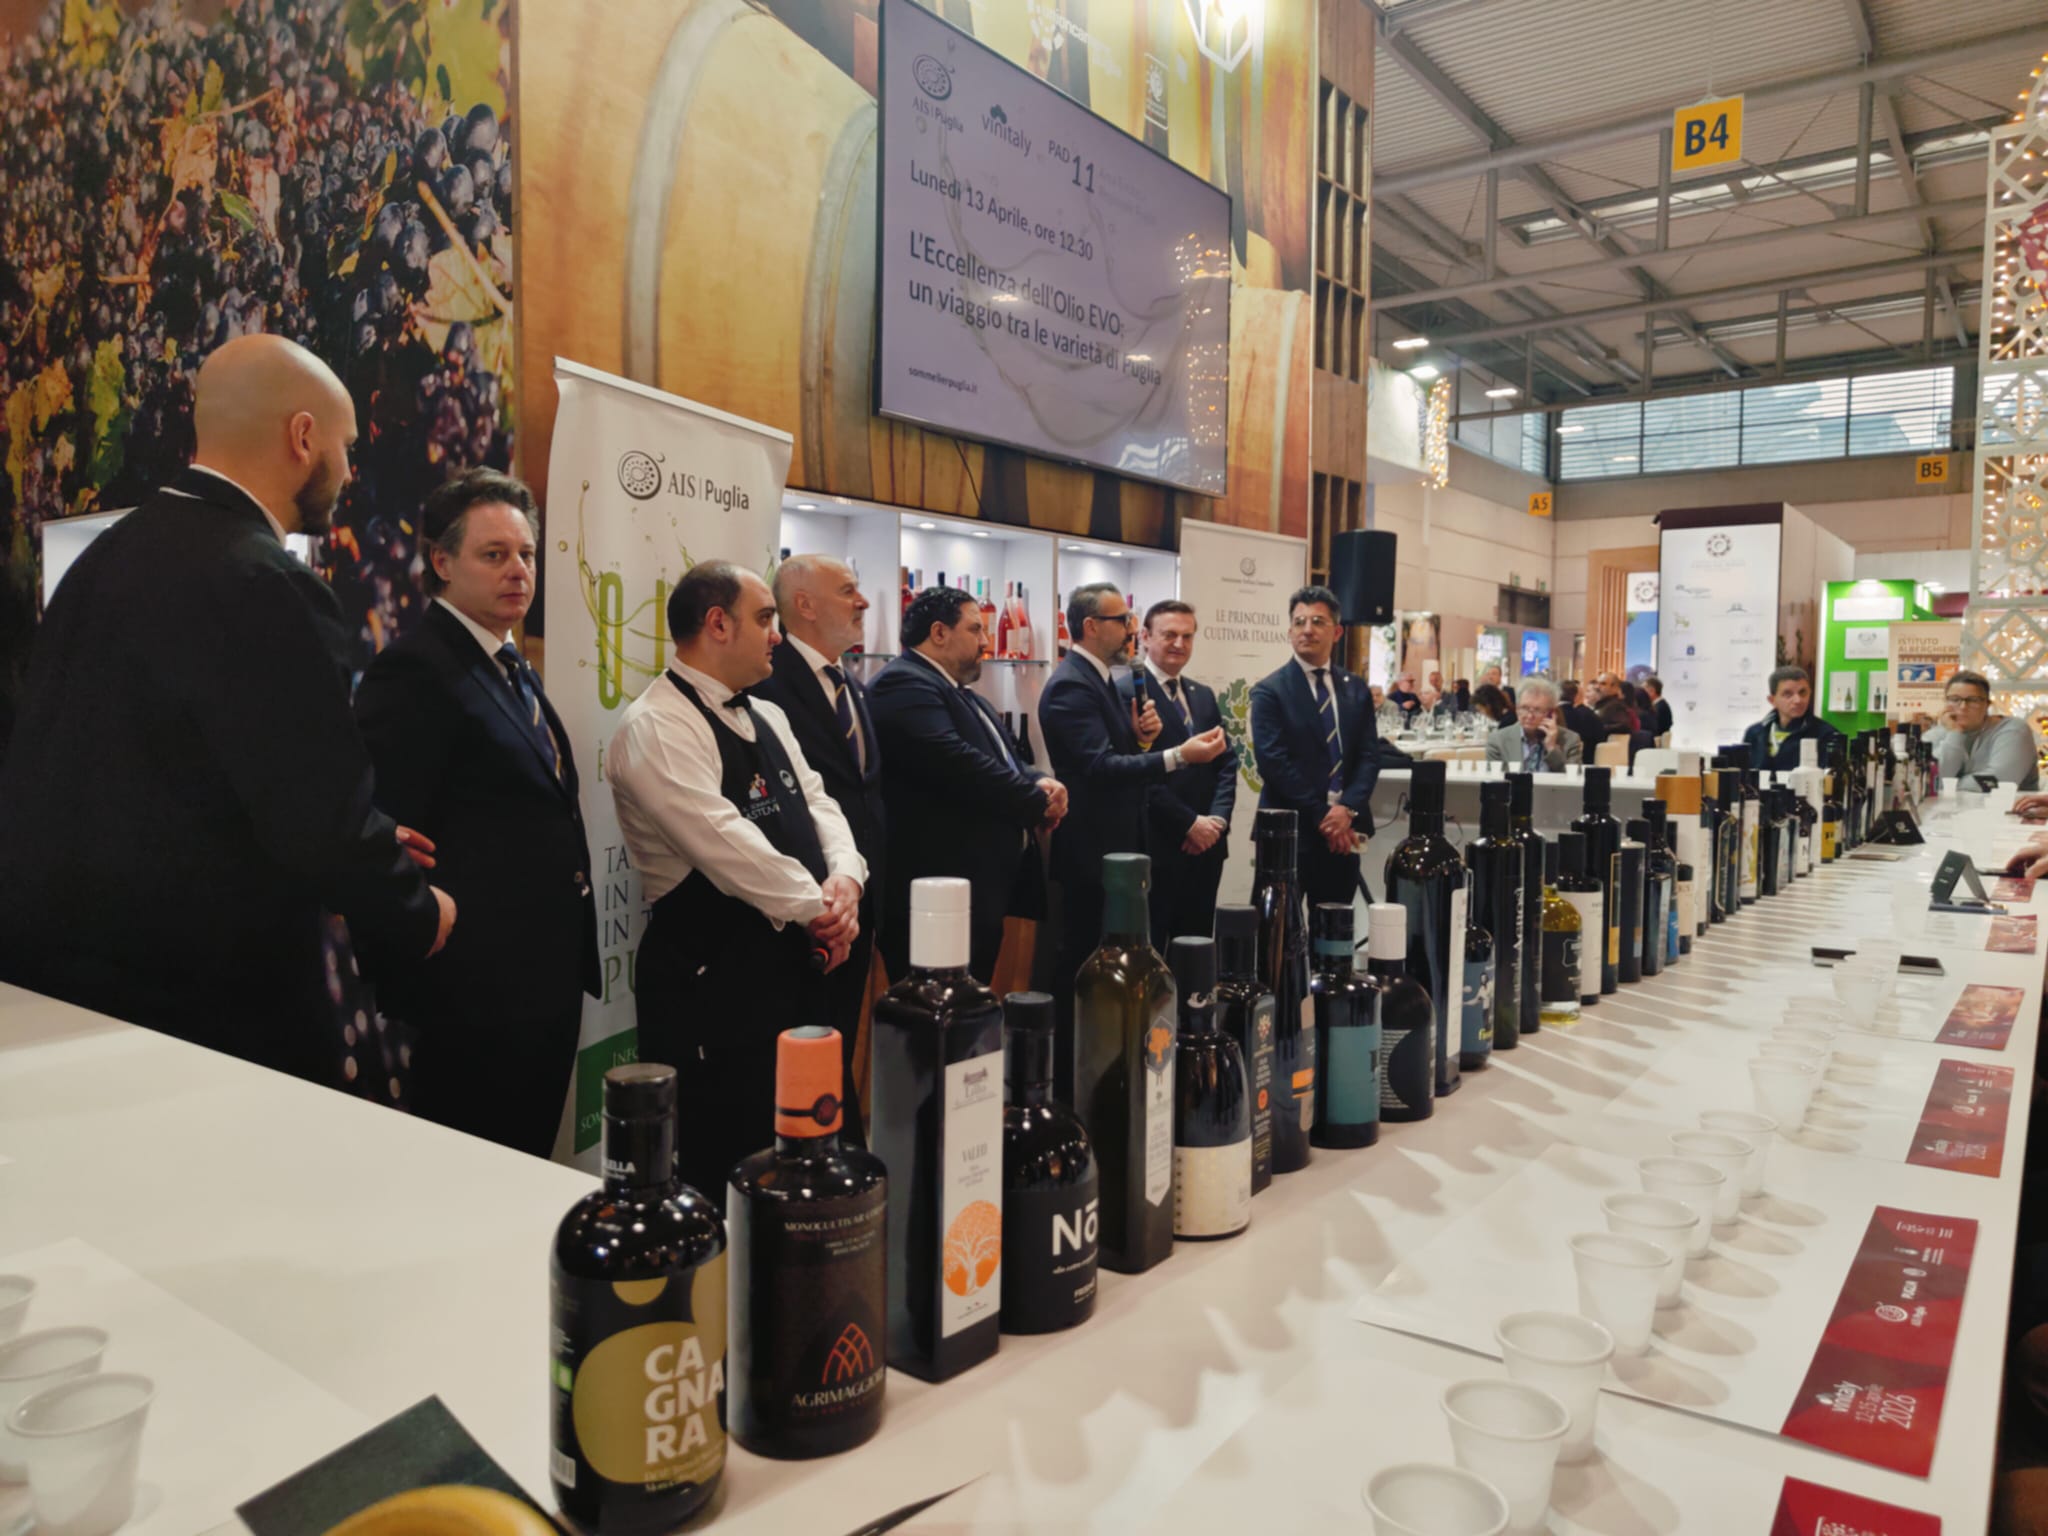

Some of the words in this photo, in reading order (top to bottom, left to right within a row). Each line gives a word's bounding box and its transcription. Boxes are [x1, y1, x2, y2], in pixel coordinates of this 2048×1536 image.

[1684, 113, 1729, 157] B4
[1048, 140, 1070, 164] PAD
[1072, 155, 1095, 193] 11
[966, 187, 984, 212] 13
[987, 197, 1032, 235] Aprile,
[1034, 222, 1056, 245] ore
[910, 229, 1017, 294] L'Eccellenza
[1021, 276, 1085, 324] dell'Olio
[908, 279, 933, 306] un
[938, 287, 1002, 329] viaggio
[1006, 313, 1030, 339] tra
[1034, 319, 1048, 346] le
[1051, 330, 1102, 366] varietà
[1106, 346, 1119, 369] di
[1122, 352, 1162, 387] Puglia
[1919, 461, 1944, 479] B5
[667, 471, 697, 498] AIS
[704, 479, 750, 513] Puglia
[1531, 496, 1549, 513] A5
[1203, 626, 1250, 642] CULTIVAR
[1215, 608, 1226, 623] LE
[1227, 610, 1280, 627] PRINCIPALI
[604, 913, 630, 949] IN
[643, 1335, 705, 1384] CA
[1878, 1392, 1917, 1430] 2026
[644, 1411, 709, 1466] RA
